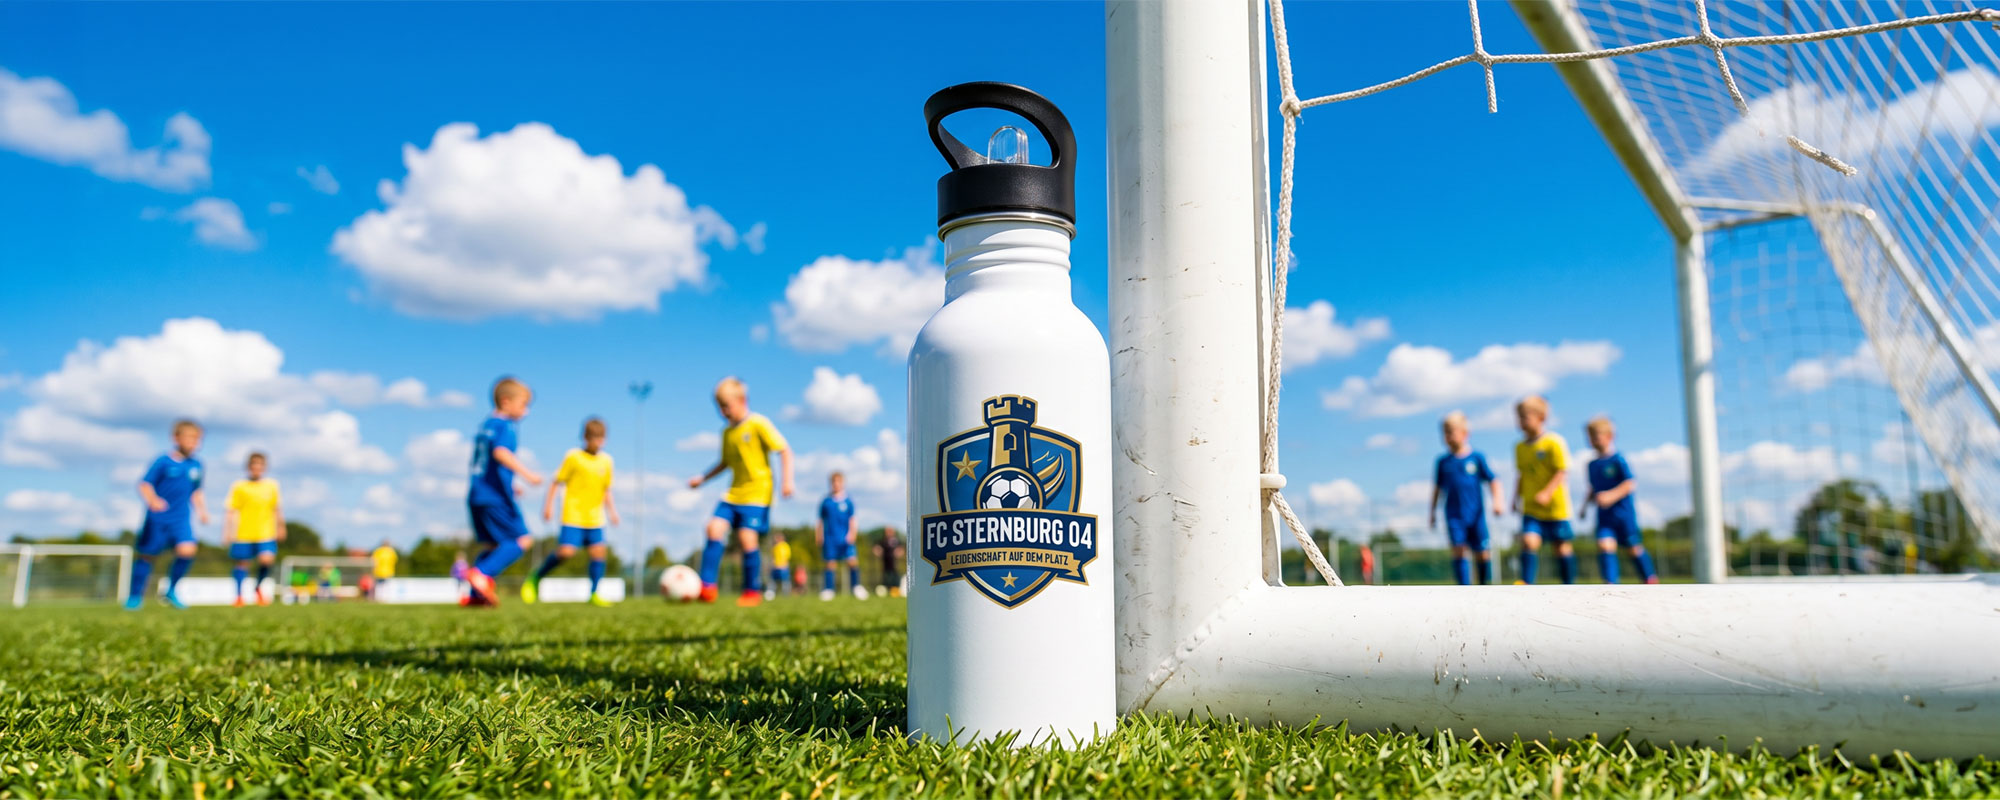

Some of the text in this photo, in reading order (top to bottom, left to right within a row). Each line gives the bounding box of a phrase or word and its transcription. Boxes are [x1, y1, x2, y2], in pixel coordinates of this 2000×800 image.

[927, 517, 1092, 550] FC STERNBURG 04
[951, 551, 1069, 566] LEIDENSCHAFT AUF DEM PLATZ
